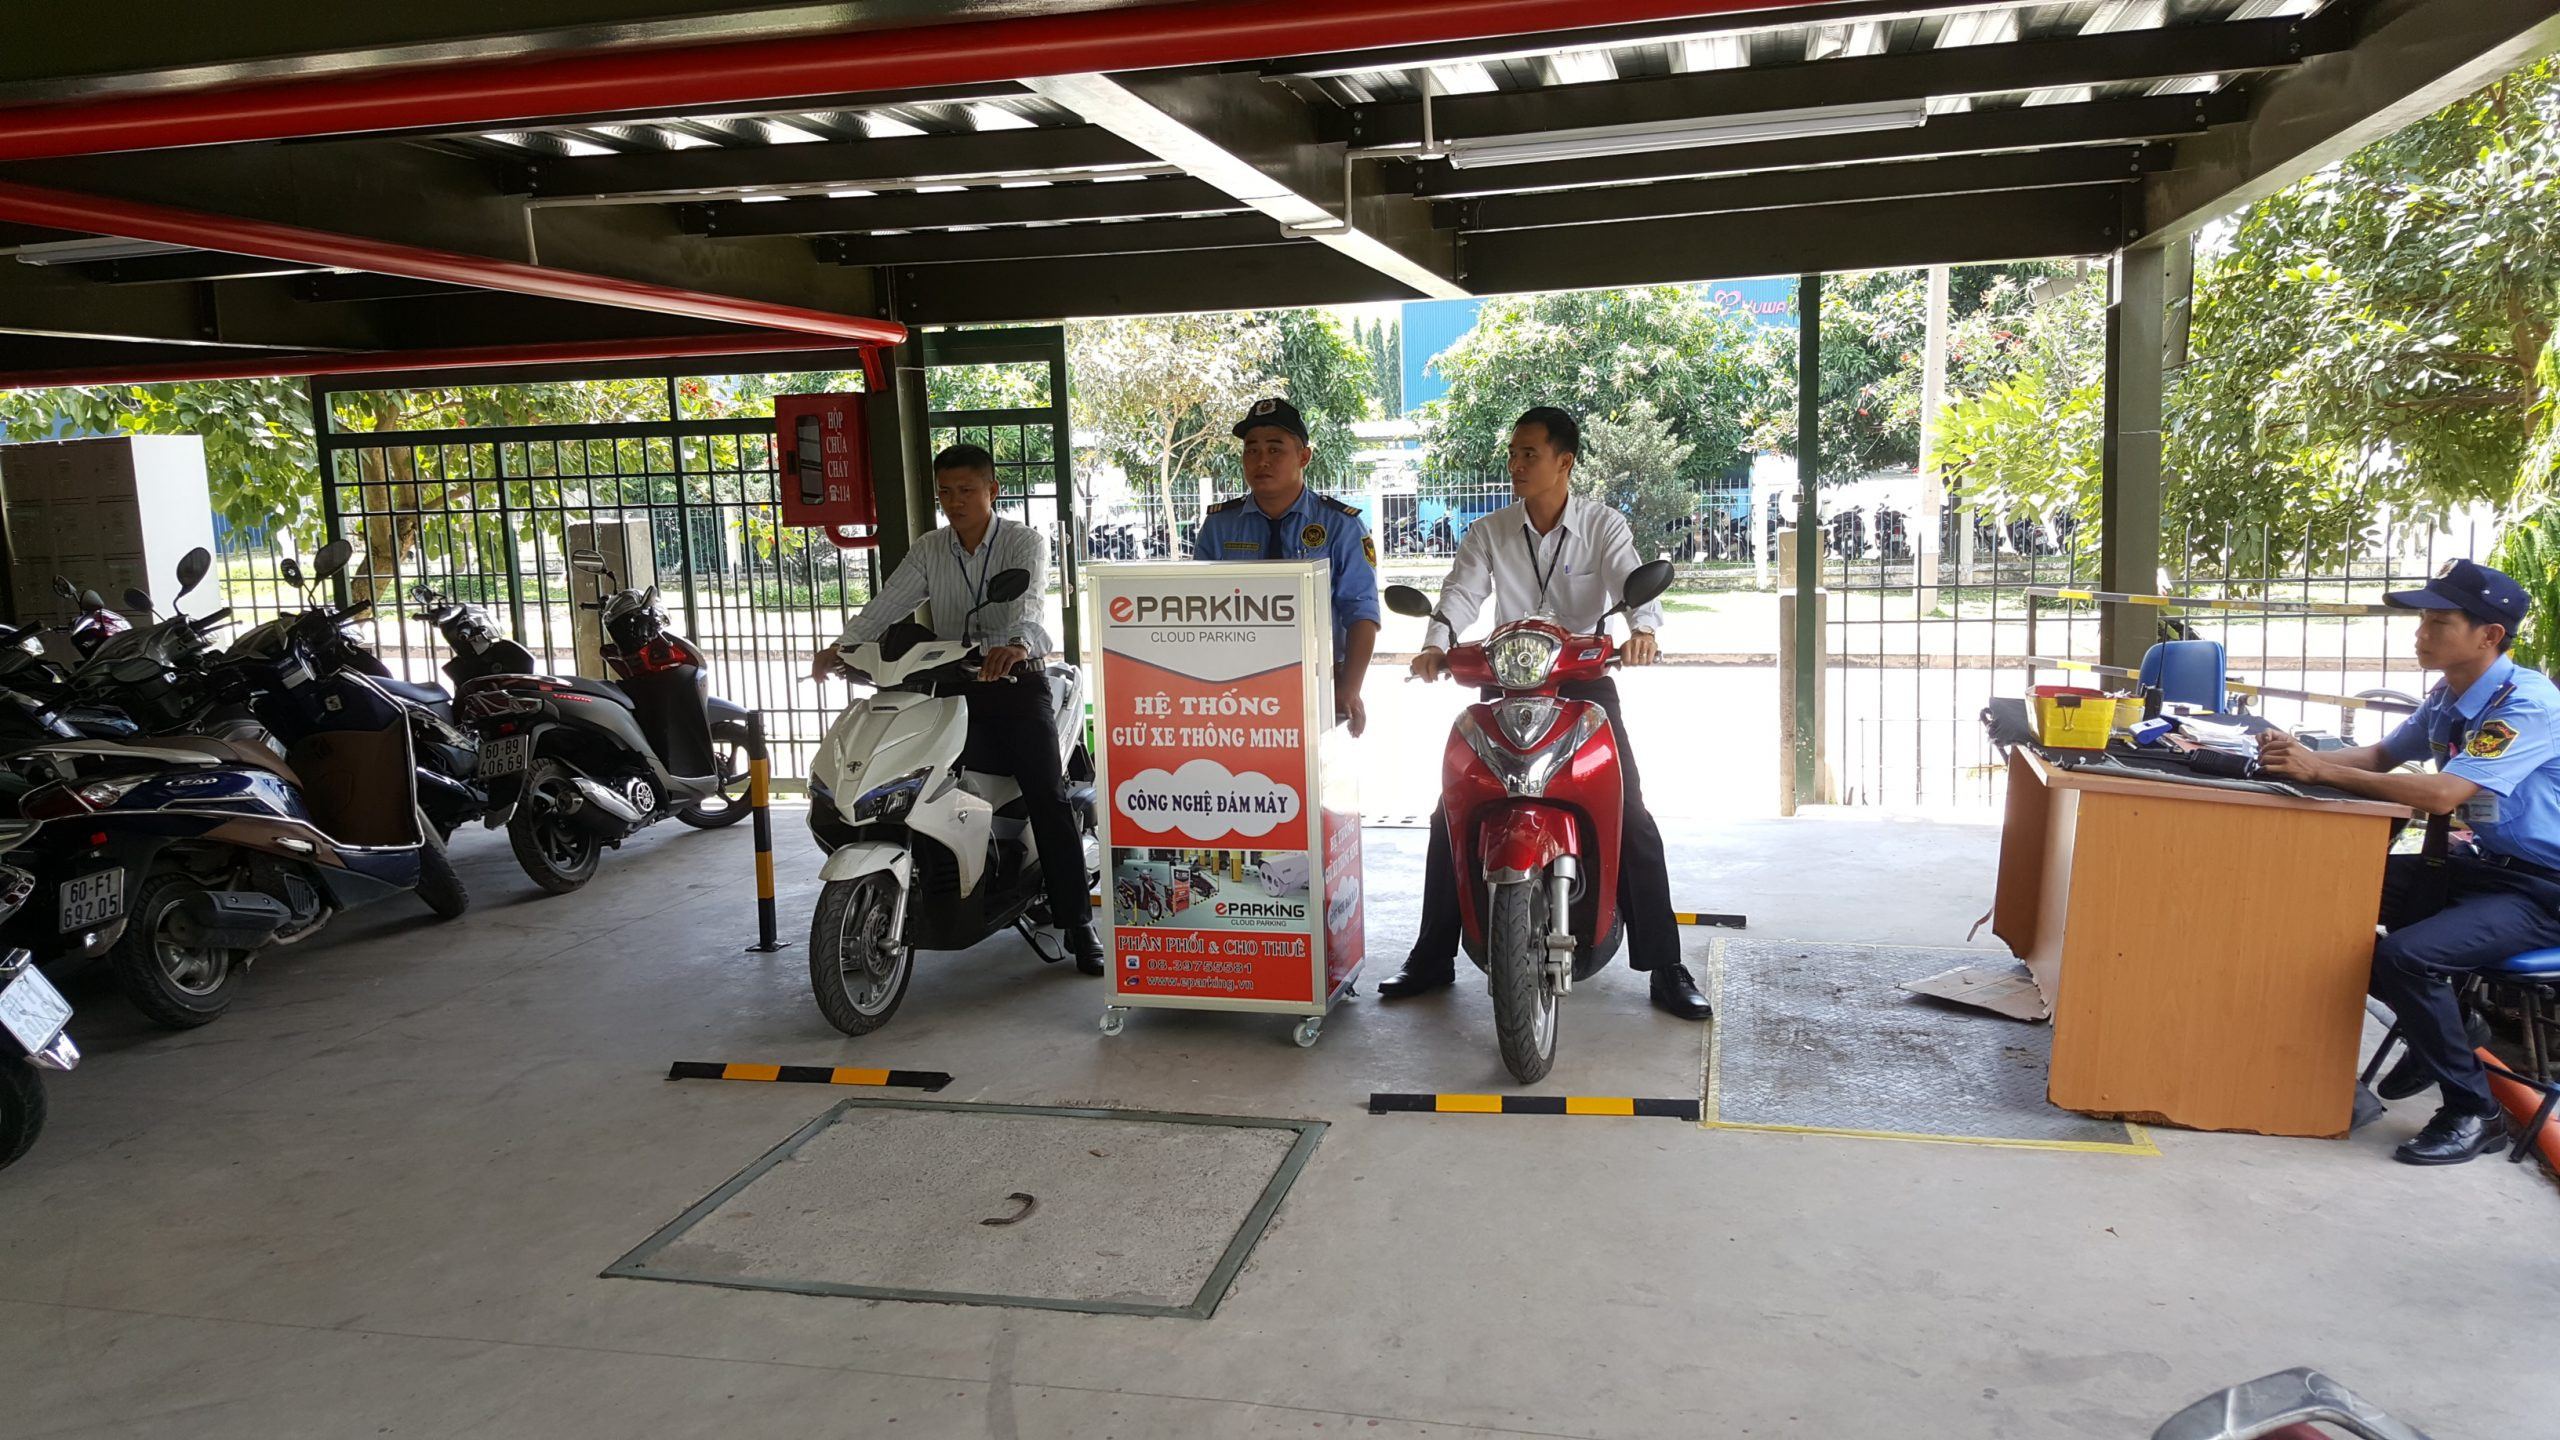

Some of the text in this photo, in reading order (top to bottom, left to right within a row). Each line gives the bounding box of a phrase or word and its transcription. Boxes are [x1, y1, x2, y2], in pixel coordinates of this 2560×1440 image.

[827, 456, 849, 478] CHÁY
[1109, 588, 1295, 623] ePARKING
[1150, 631, 1256, 643] CLOUD PARKING
[1134, 688, 1281, 719] HỆ THỐNG
[1112, 722, 1299, 748] GIỮ XE THÔNG MINH
[485, 739, 519, 760] 60-B9
[1127, 789, 1289, 816] CÔNG NGHỆ ĐÁM MÂY
[70, 873, 112, 903] 60-F1
[64, 894, 118, 928] 692.05
[1231, 919, 1255, 927] CLOUD
[1118, 932, 1306, 958] PHÂN PHỐI & CHO THUÊ
[1147, 976, 1254, 992] www.eparking.vn
